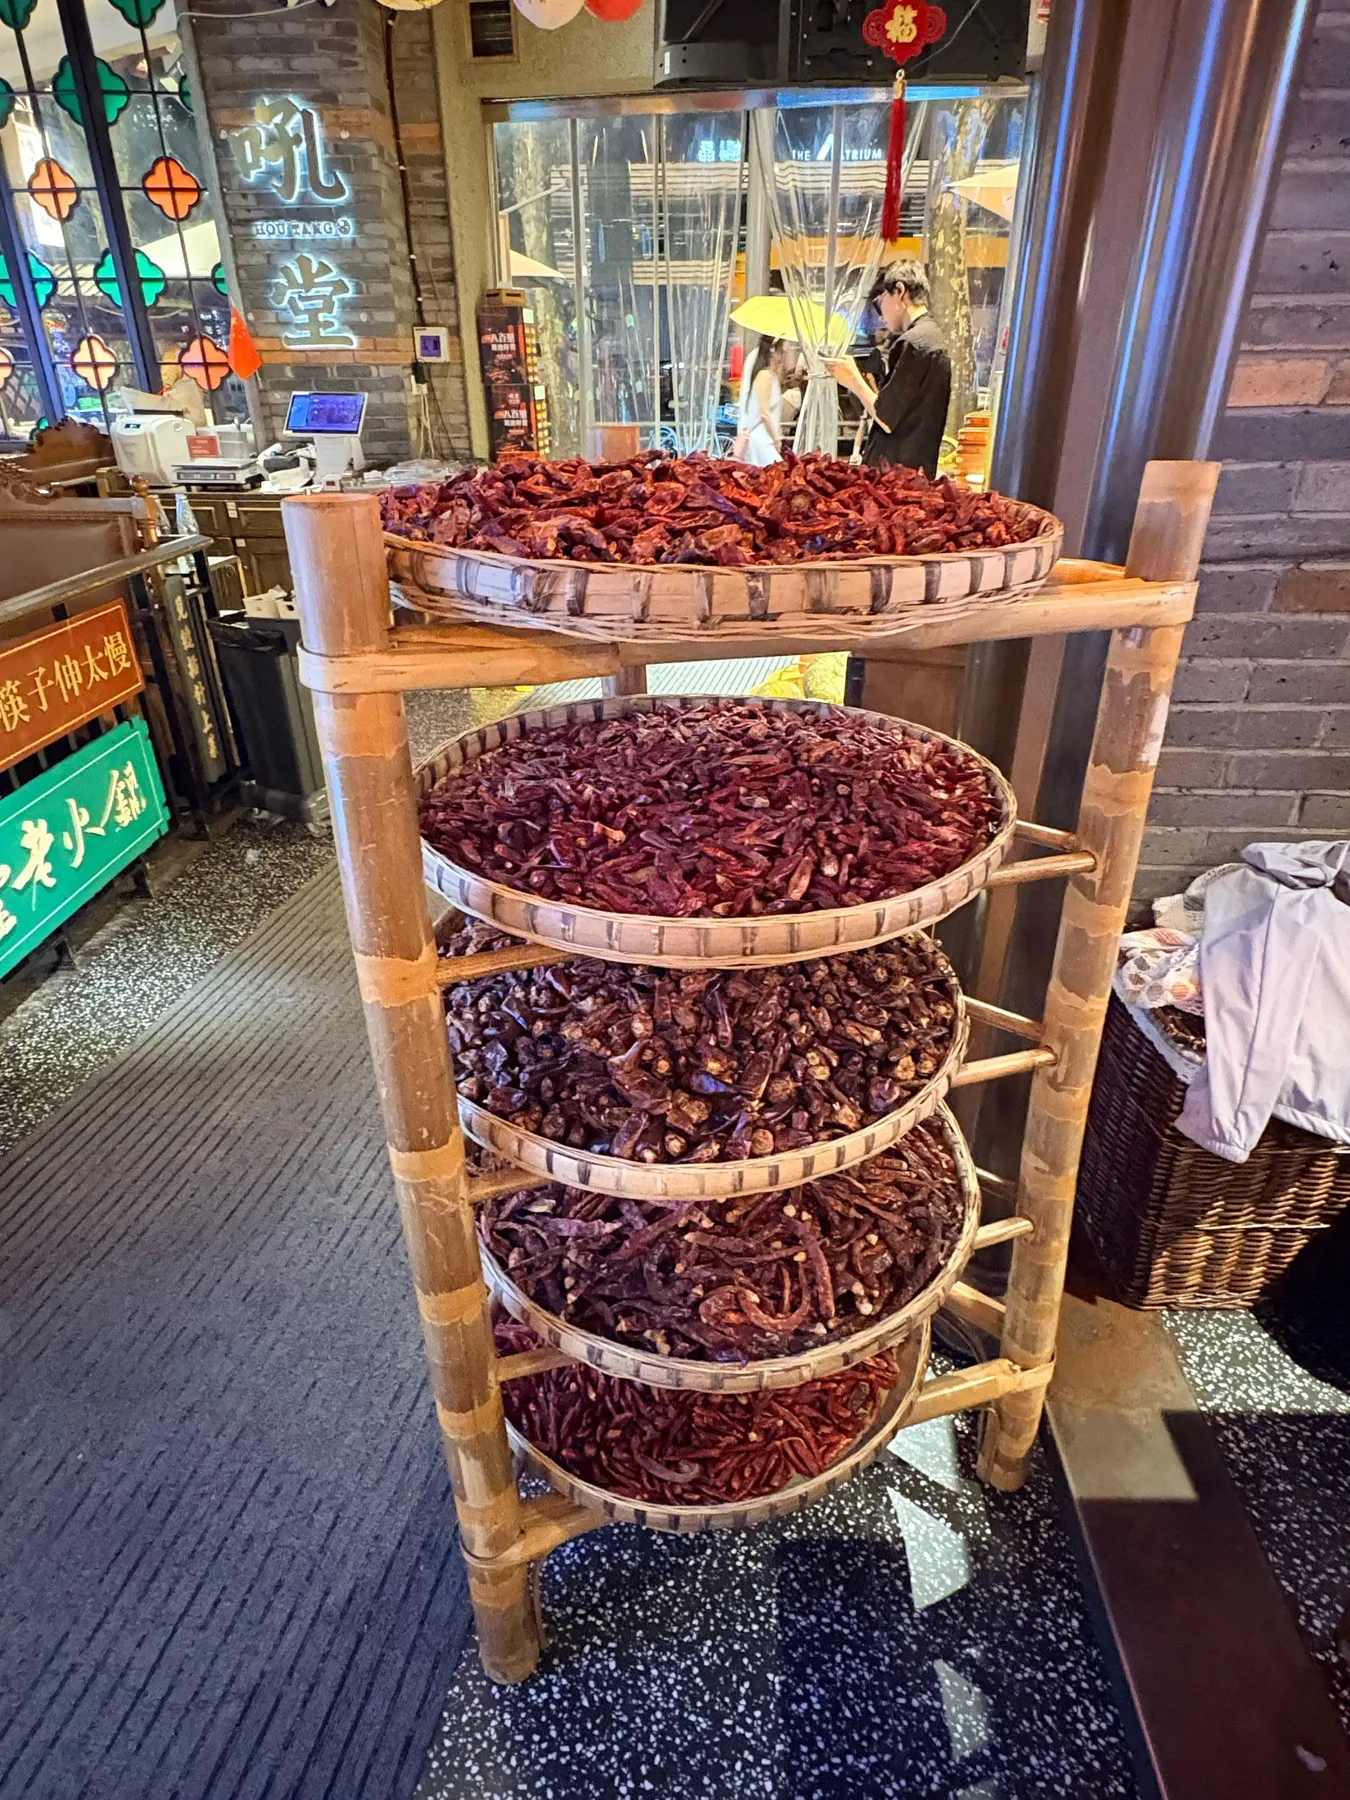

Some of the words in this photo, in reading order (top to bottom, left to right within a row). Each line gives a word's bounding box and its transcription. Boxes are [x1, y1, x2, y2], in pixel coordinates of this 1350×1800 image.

[885, 5, 918, 43] 福
[792, 149, 811, 161] THE
[254, 220, 286, 237] HOU
[0, 631, 131, 732] 筷子伸太慢
